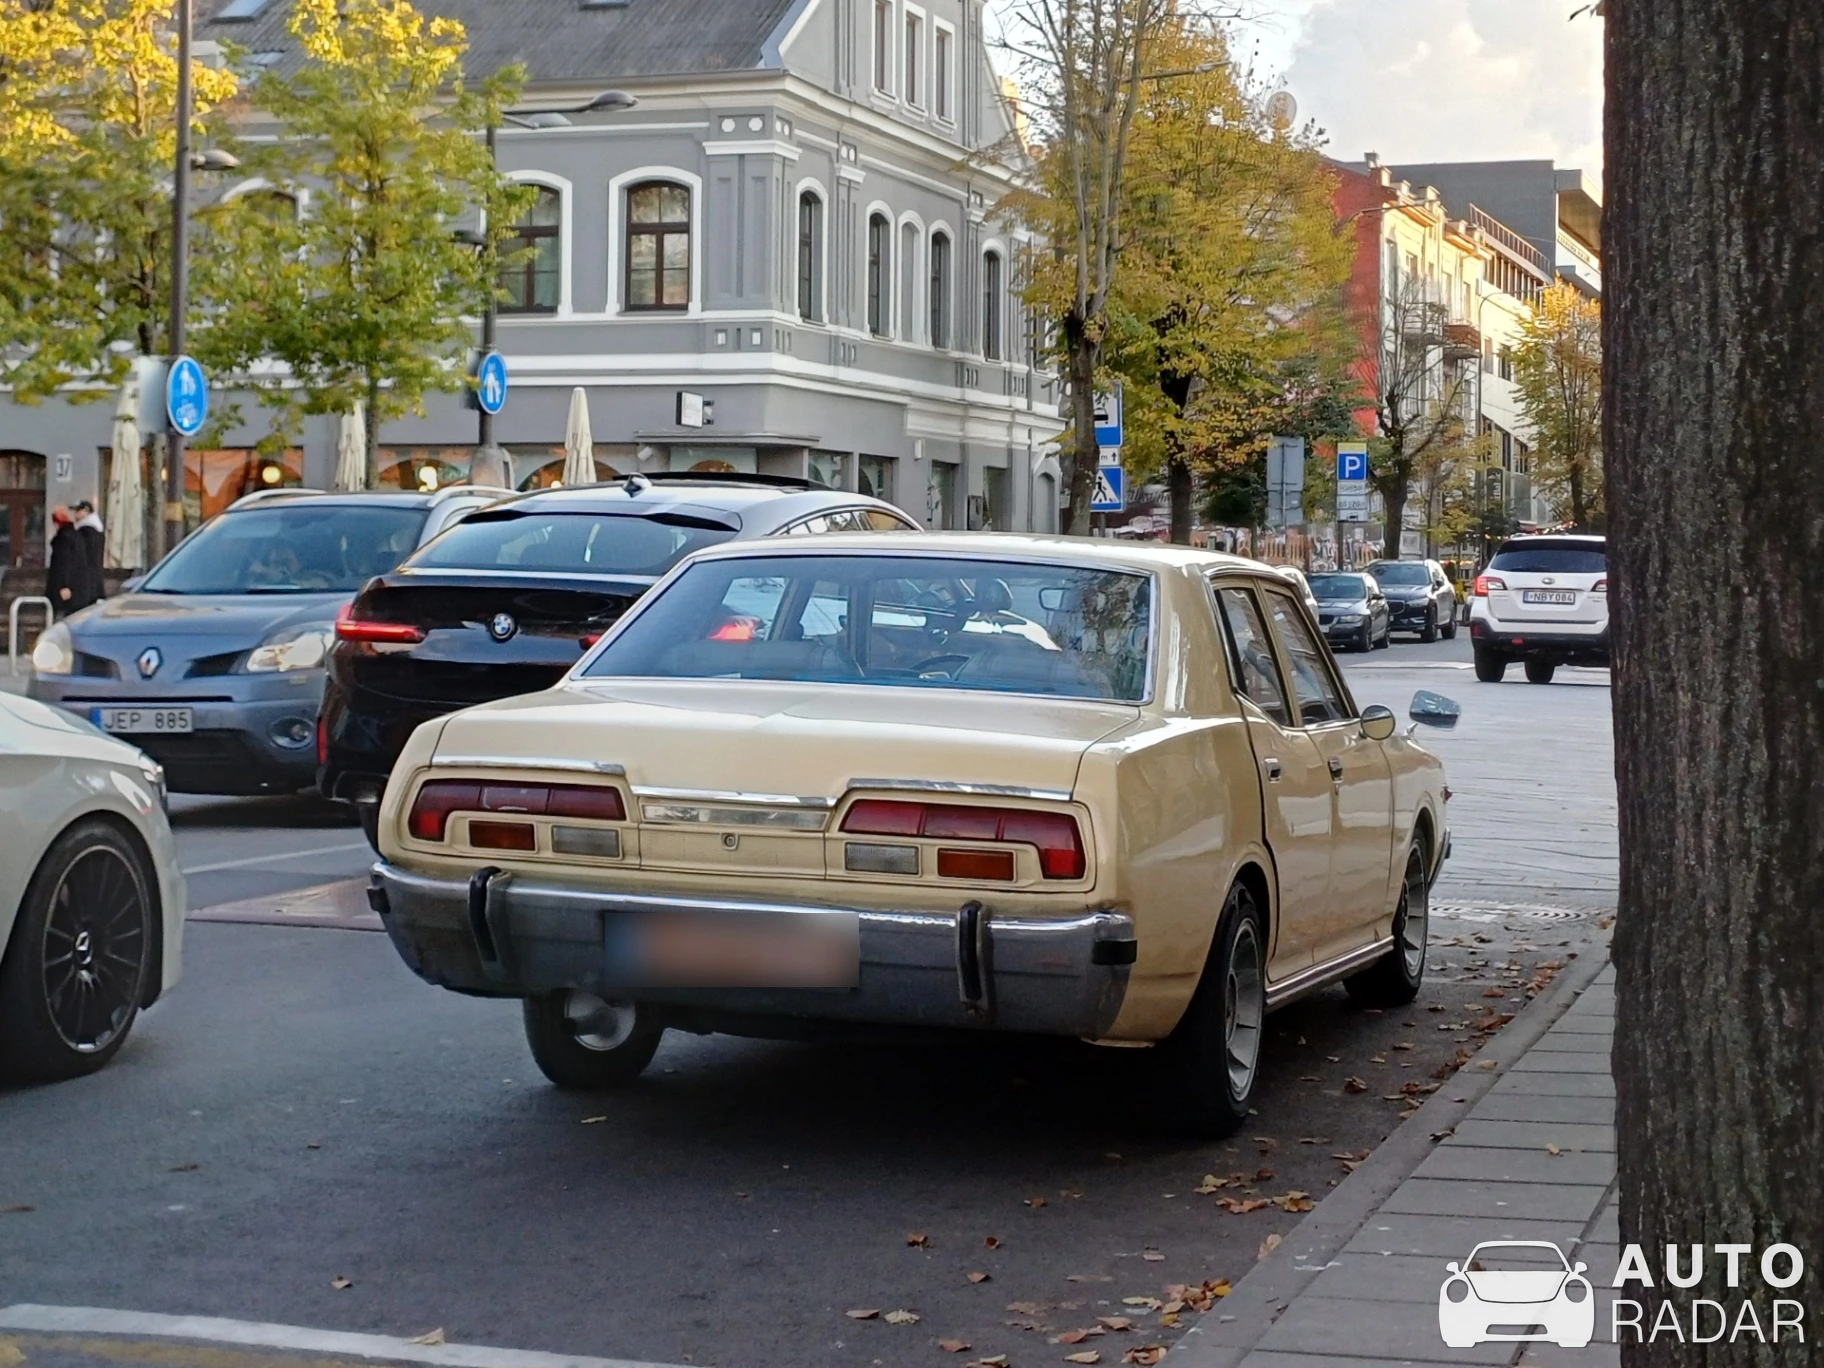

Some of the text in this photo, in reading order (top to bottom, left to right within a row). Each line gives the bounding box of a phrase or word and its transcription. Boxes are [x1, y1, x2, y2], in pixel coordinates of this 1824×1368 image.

[1345, 455, 1360, 479] P
[104, 711, 189, 730] JEP 885
